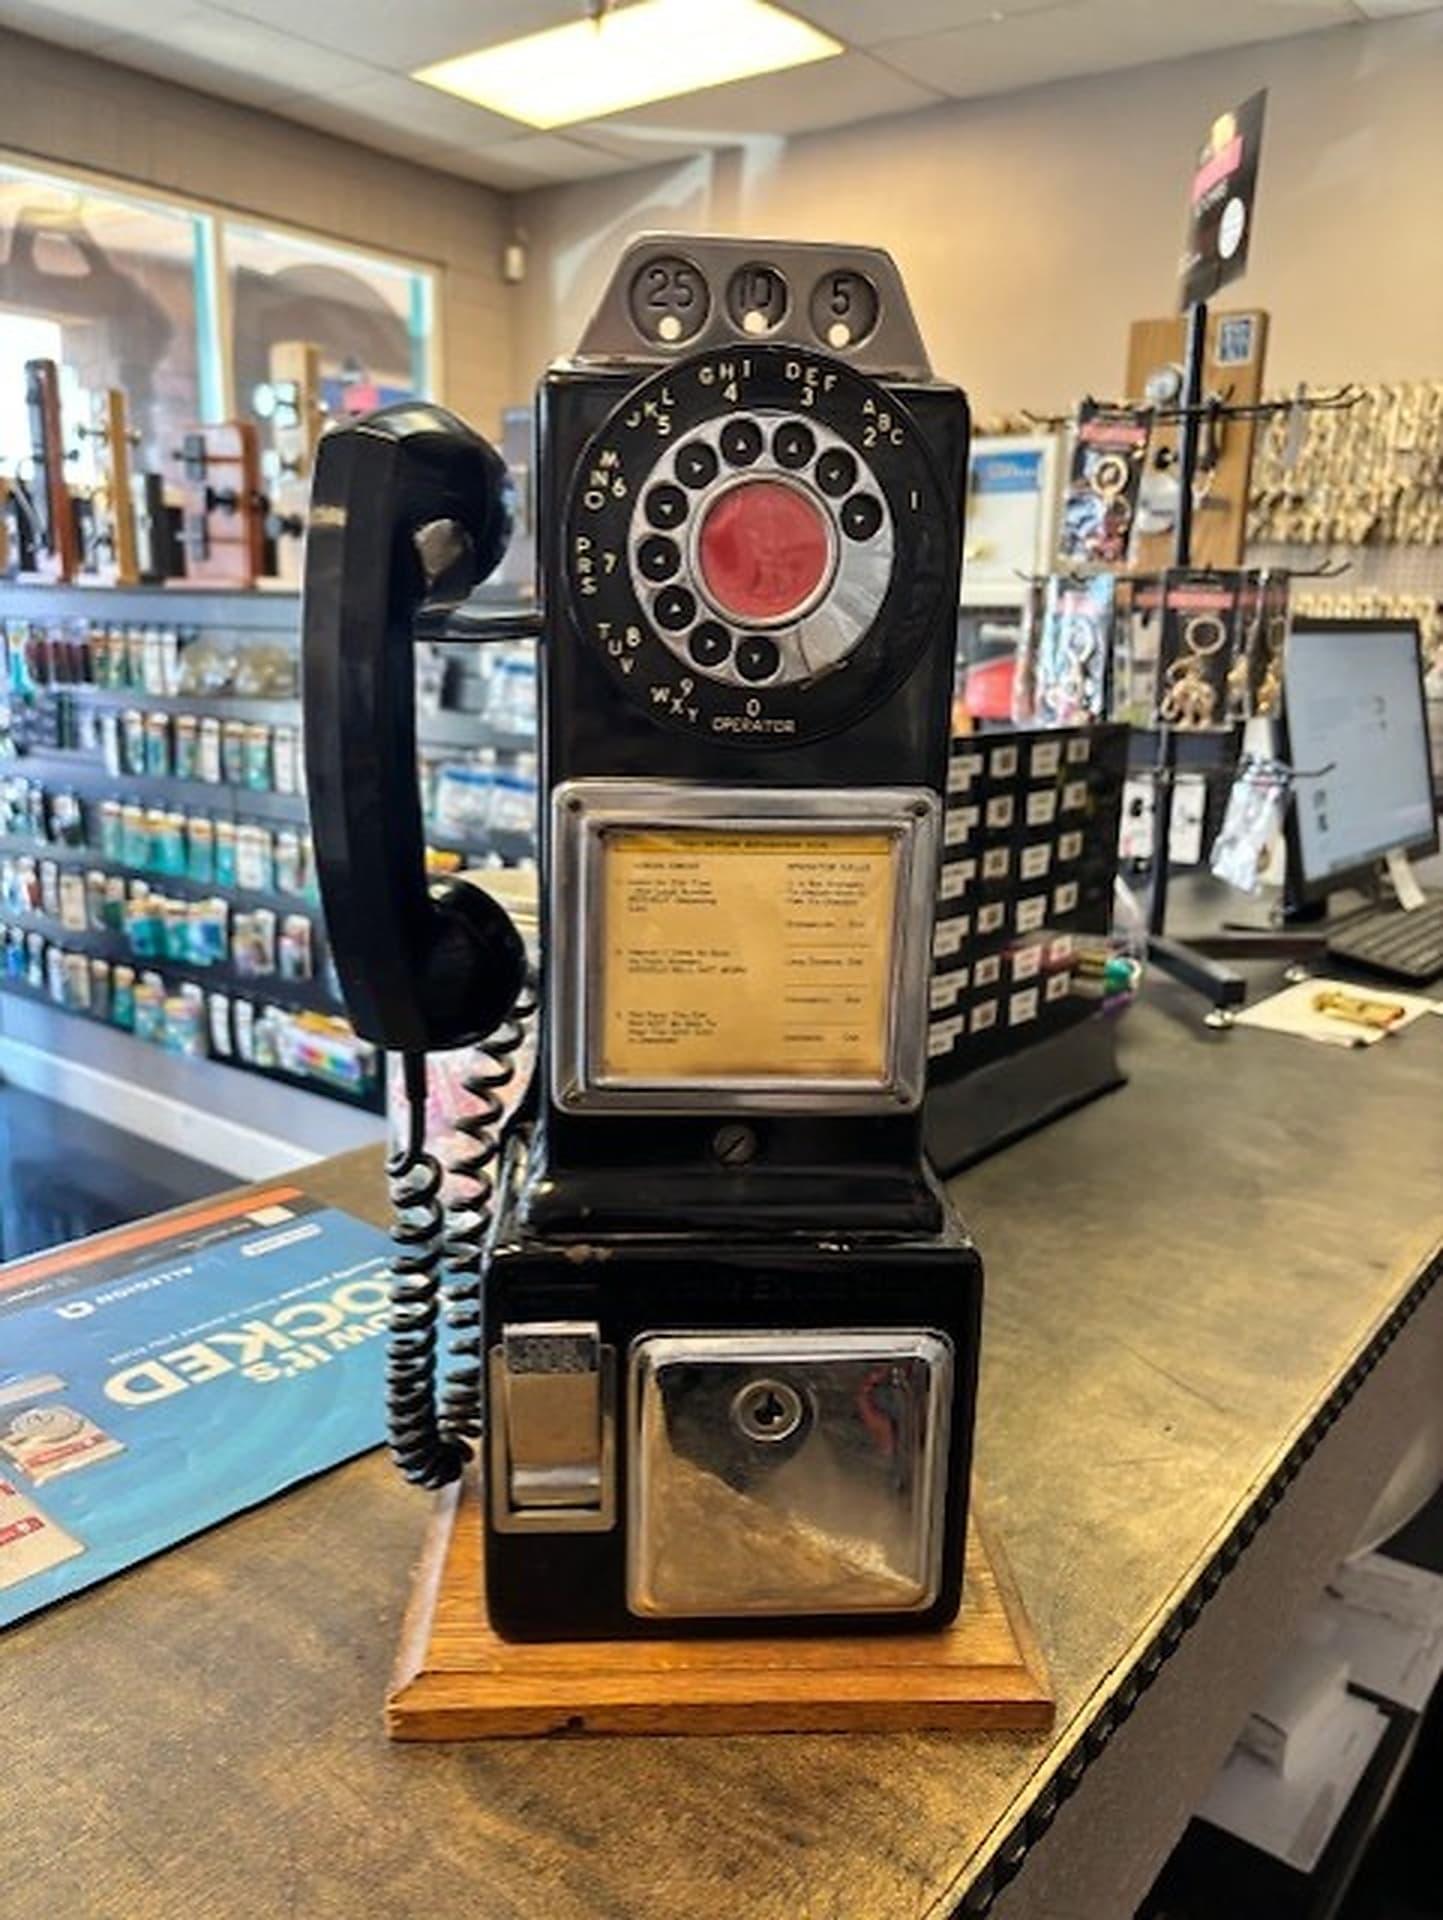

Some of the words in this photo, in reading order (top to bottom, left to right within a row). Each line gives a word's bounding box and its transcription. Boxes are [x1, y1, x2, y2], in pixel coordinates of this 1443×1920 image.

[646, 266, 695, 309] 25
[738, 270, 774, 310] 10
[829, 276, 851, 317] 5
[723, 383, 739, 403] 4
[801, 386, 815, 407] 3
[656, 415, 672, 436] 5
[862, 427, 878, 448] 2
[610, 475, 628, 498] 6
[602, 552, 620, 575] 7
[624, 625, 643, 649] 8
[679, 677, 695, 698] 9
[712, 715, 796, 734] OPERATOR
[104, 1268, 393, 1408] OCKED
